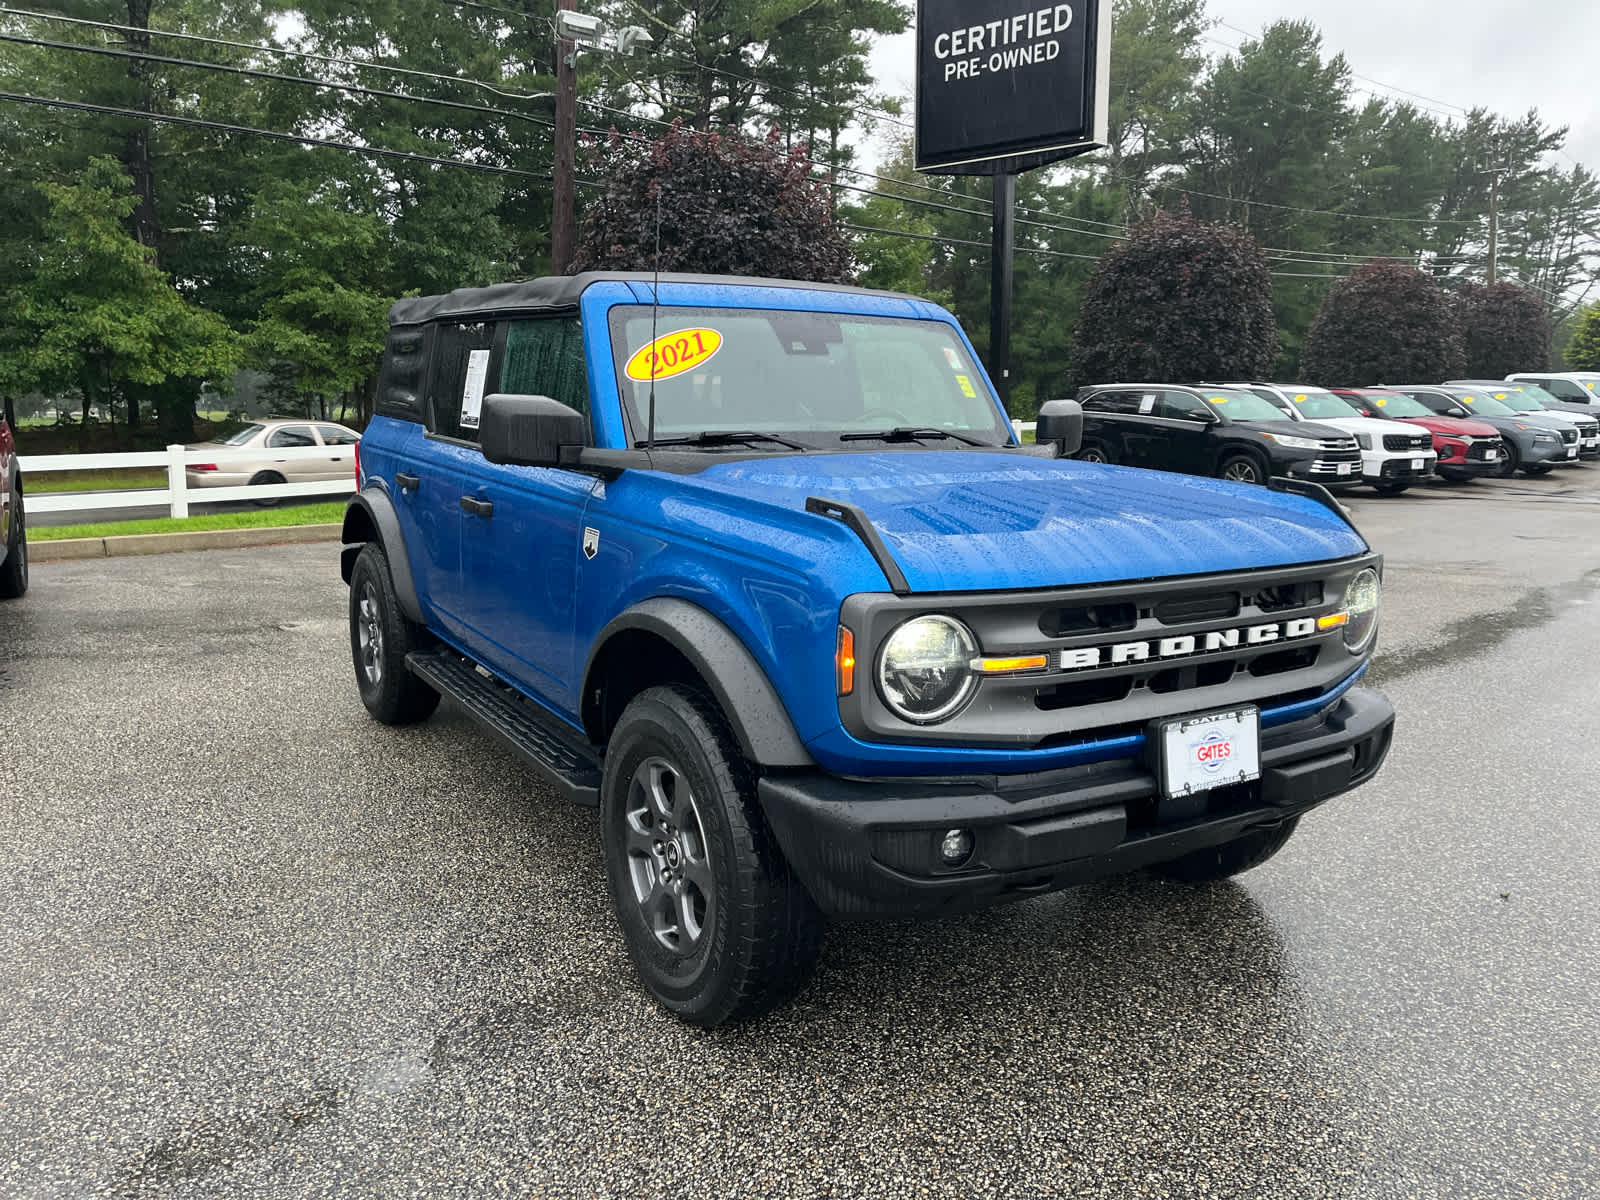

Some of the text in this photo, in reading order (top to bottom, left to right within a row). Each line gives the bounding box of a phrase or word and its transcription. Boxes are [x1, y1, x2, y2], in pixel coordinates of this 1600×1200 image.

[934, 4, 1073, 59] CERTIFIED
[944, 40, 1060, 82] PRE-OWNED
[644, 332, 708, 377] 2021
[1060, 617, 1316, 669] BRONCO
[1197, 741, 1231, 762] GATES
